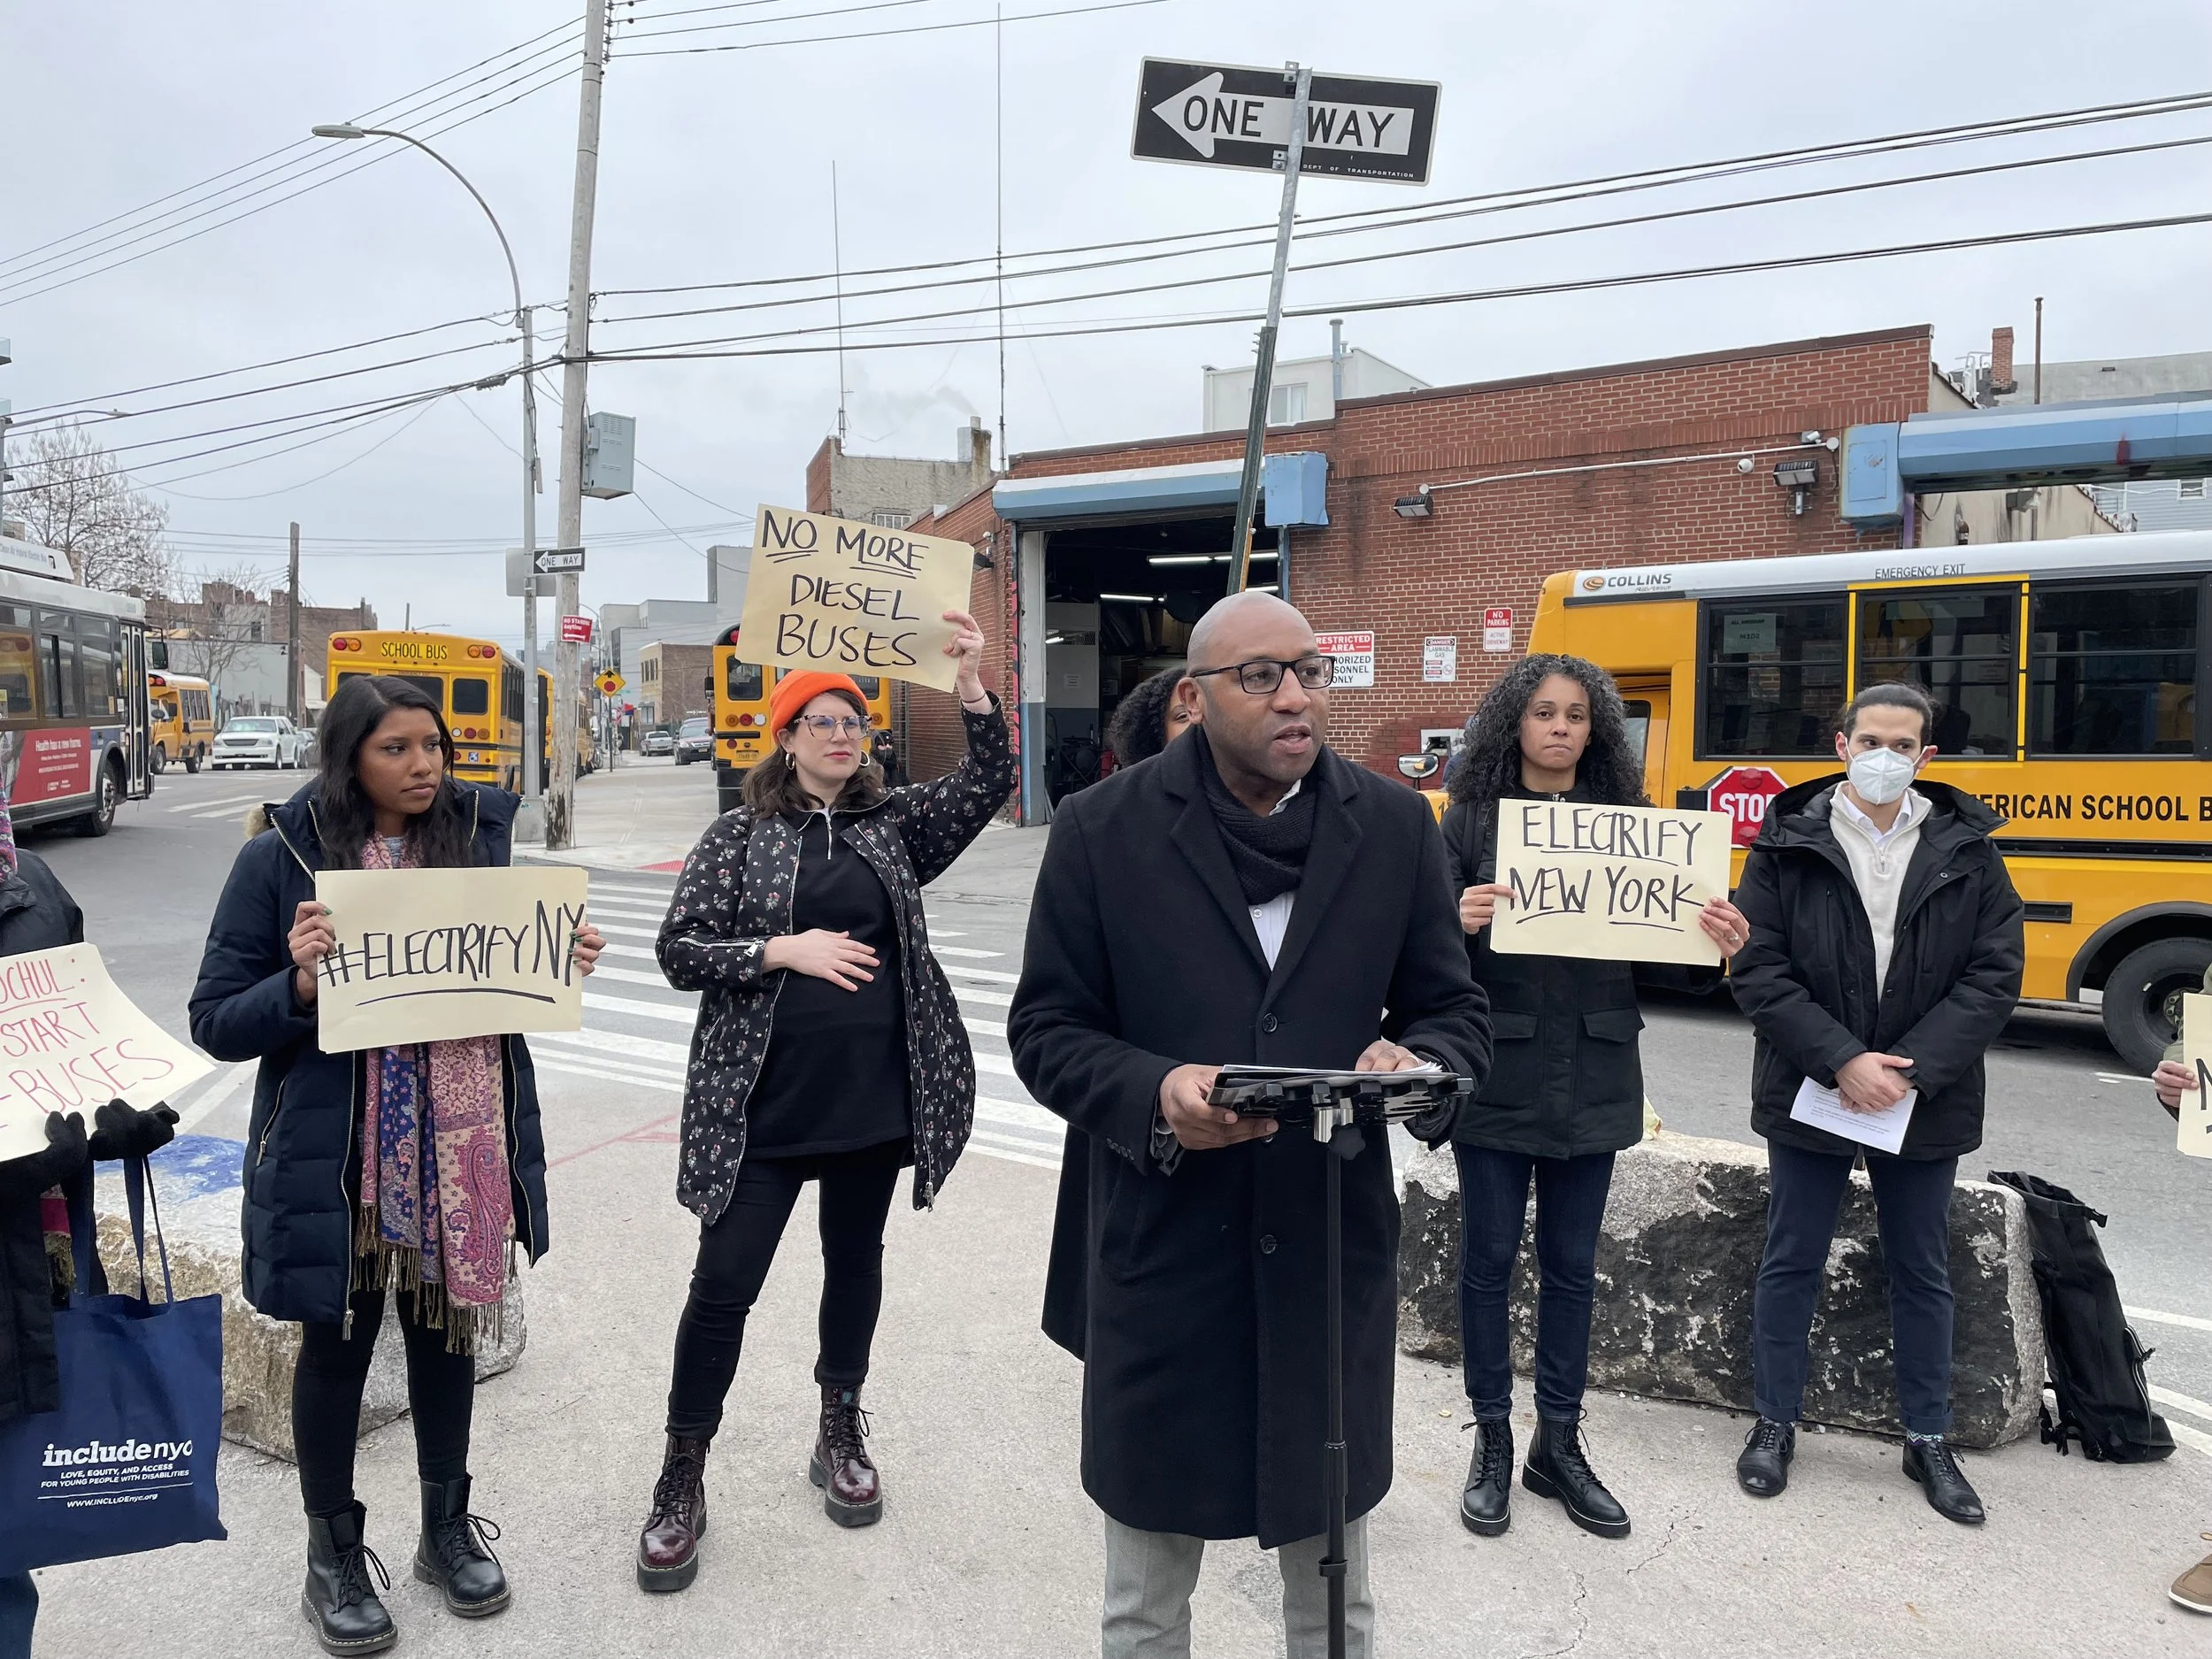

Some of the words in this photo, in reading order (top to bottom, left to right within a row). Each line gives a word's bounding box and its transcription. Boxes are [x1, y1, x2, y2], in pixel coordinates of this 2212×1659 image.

[1183, 95, 1264, 137] ONE
[1306, 106, 1395, 148] WAY
[1347, 167, 1415, 178] TRANSPORTATION
[761, 510, 818, 549] NO
[836, 526, 929, 572] MORE
[541, 556, 557, 567] ONE
[562, 555, 580, 565] WAY
[1875, 565, 1939, 580] EMERGENCY
[1942, 563, 1966, 575] EXIT
[1608, 573, 1672, 588] COLLINS
[790, 573, 920, 621] DIESEL
[1492, 611, 1504, 619] NO
[776, 613, 918, 667] BUSES
[1316, 635, 1371, 645] RESTRICTED
[1331, 643, 1356, 652] AREA
[381, 641, 423, 658] SCHOOL
[426, 644, 448, 660] BUS
[1336, 655, 1371, 664] ORIZED
[1334, 665, 1370, 674] SONNEL
[1332, 675, 1354, 684] ONLY
[2081, 795, 2189, 821] SCHOOL
[1522, 805, 1703, 865] ELECTRIFY
[1509, 867, 1593, 911] NEW
[1604, 865, 1705, 922] YORK
[0, 1001, 101, 1057] START
[59, 1479, 88, 1487] YOUNG
[88, 1476, 119, 1485] PEOPLE
[120, 1473, 141, 1482] WITH
[142, 1469, 190, 1481] DISABILITIES
[60, 1471, 86, 1479] LOVE,
[87, 1468, 120, 1477] EQUITY,
[121, 1465, 140, 1474] AND
[142, 1463, 173, 1472] ACCESS
